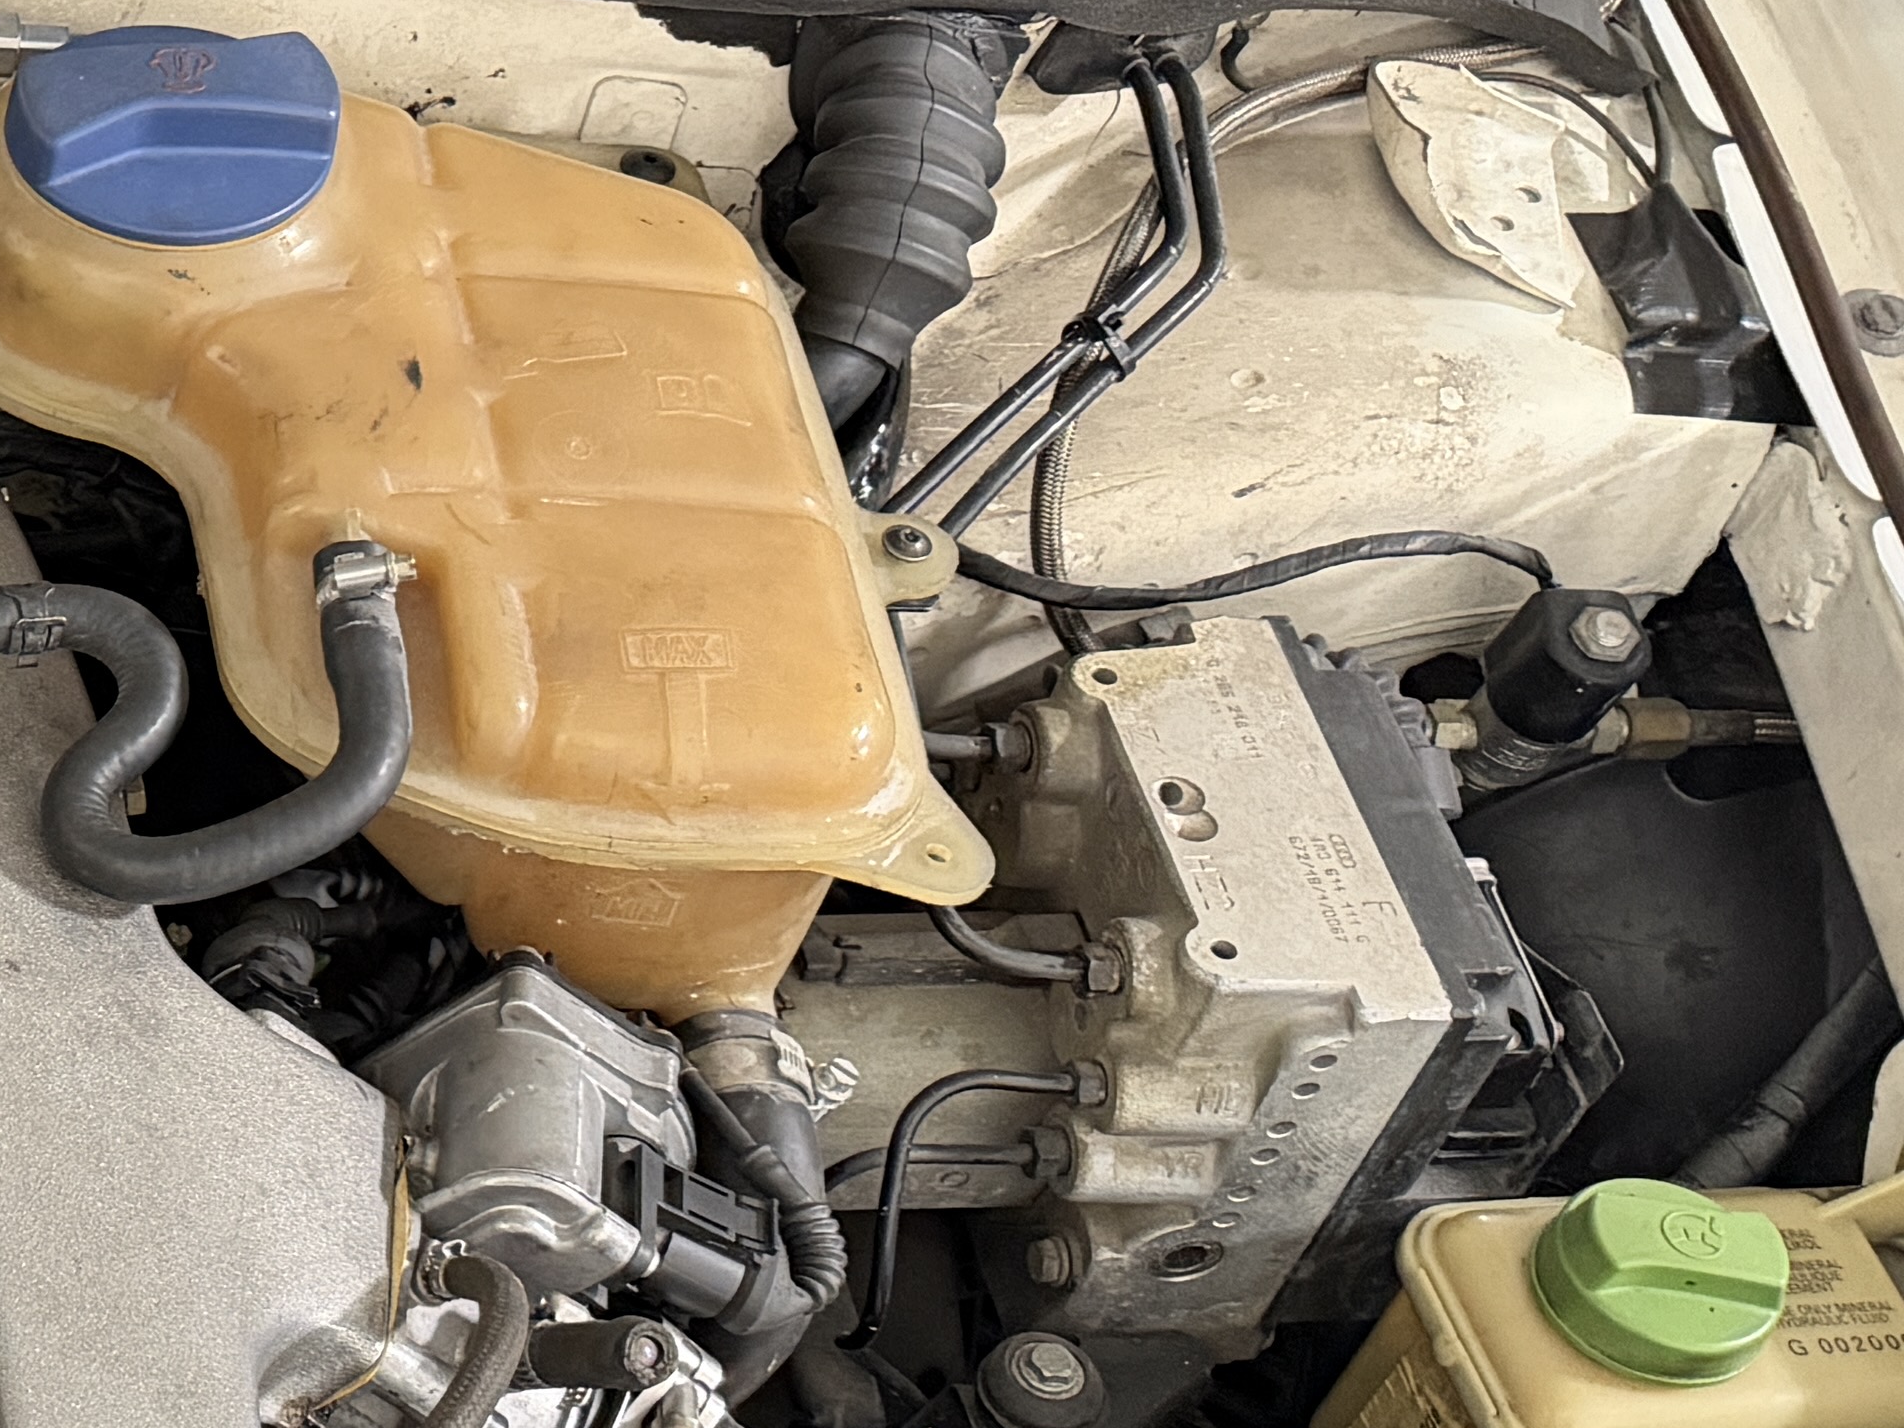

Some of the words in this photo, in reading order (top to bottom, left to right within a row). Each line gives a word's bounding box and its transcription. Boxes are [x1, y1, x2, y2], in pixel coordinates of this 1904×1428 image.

[642, 635, 713, 666] MAX
[1797, 1303, 1832, 1314] ONLY
[1834, 1301, 1893, 1312] MINERAL
[1850, 1312, 1889, 1324] FLUID
[1787, 1338, 1809, 1356] G
